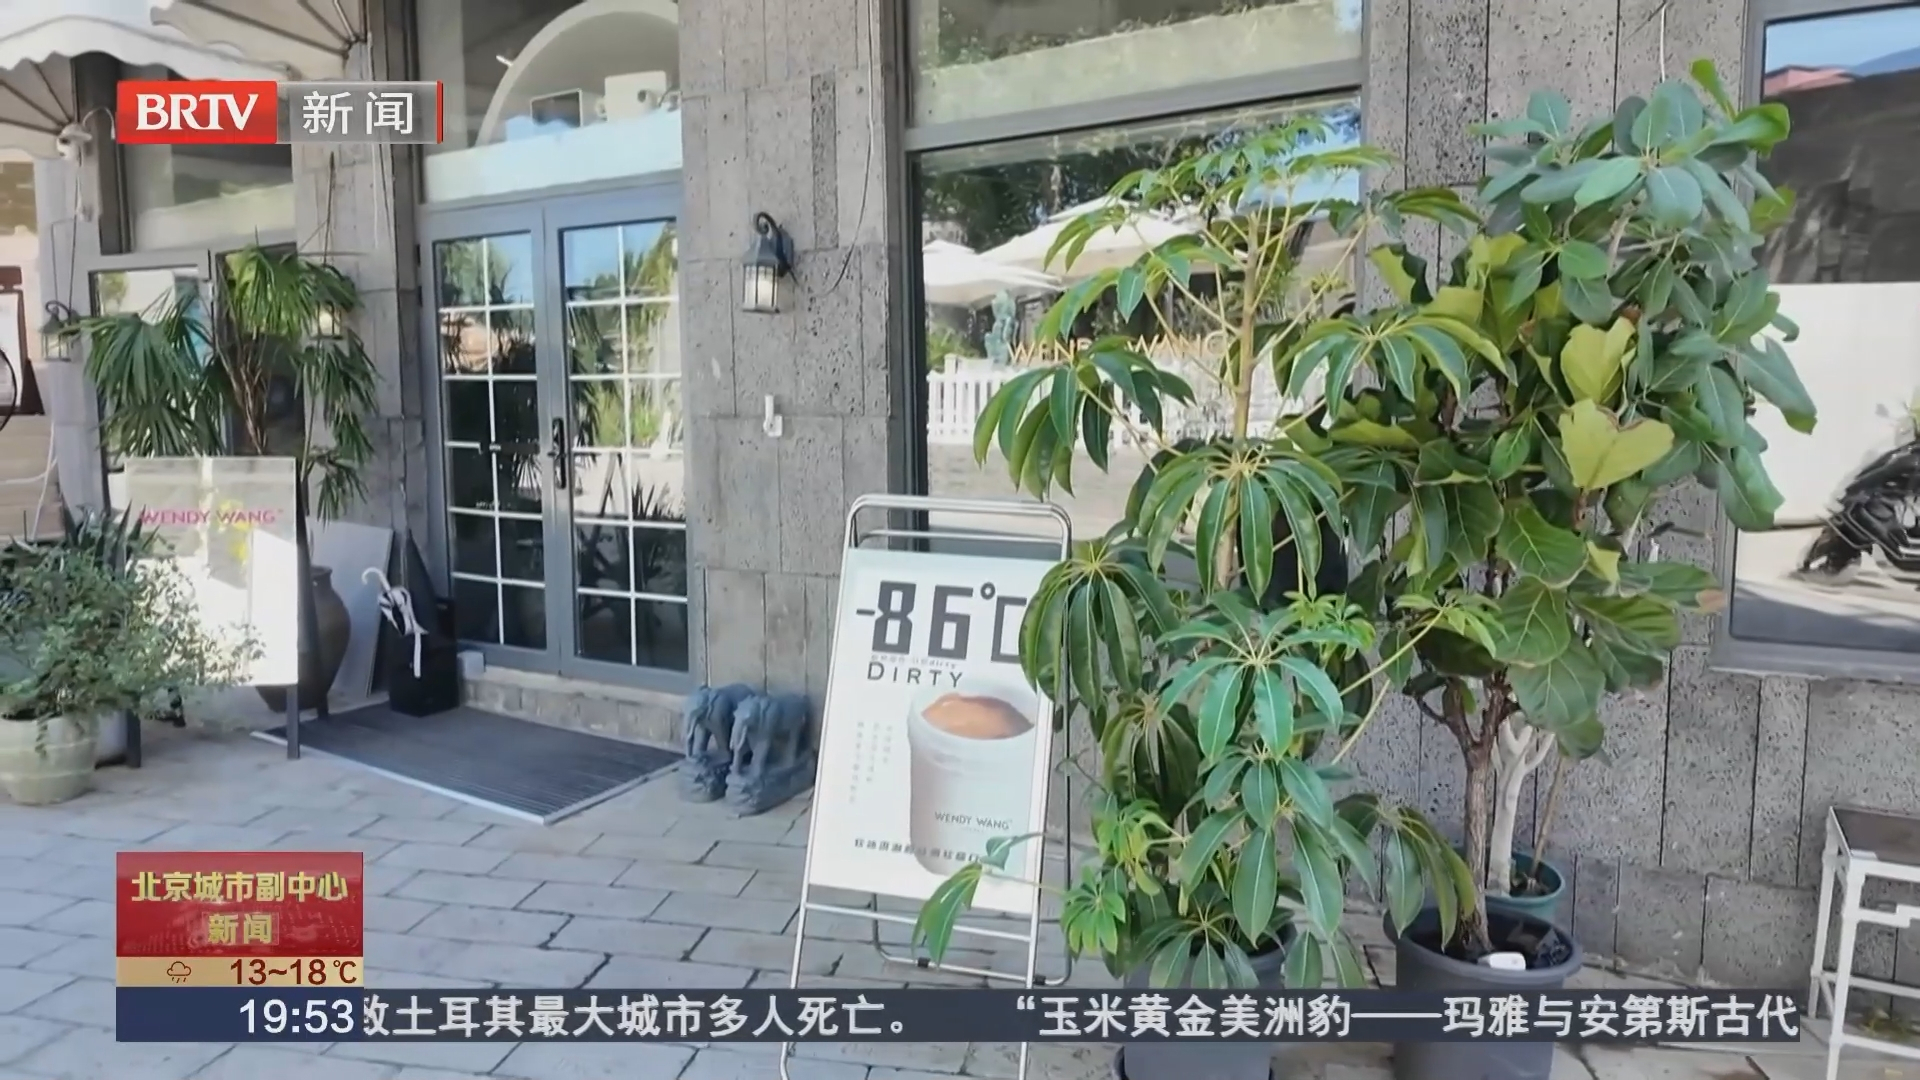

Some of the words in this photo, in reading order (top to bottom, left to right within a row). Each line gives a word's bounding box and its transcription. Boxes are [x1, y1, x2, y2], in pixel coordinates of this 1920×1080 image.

[140, 509, 211, 524] WENDY
[867, 661, 963, 688] DIRTY
[934, 811, 972, 824] WENDY
